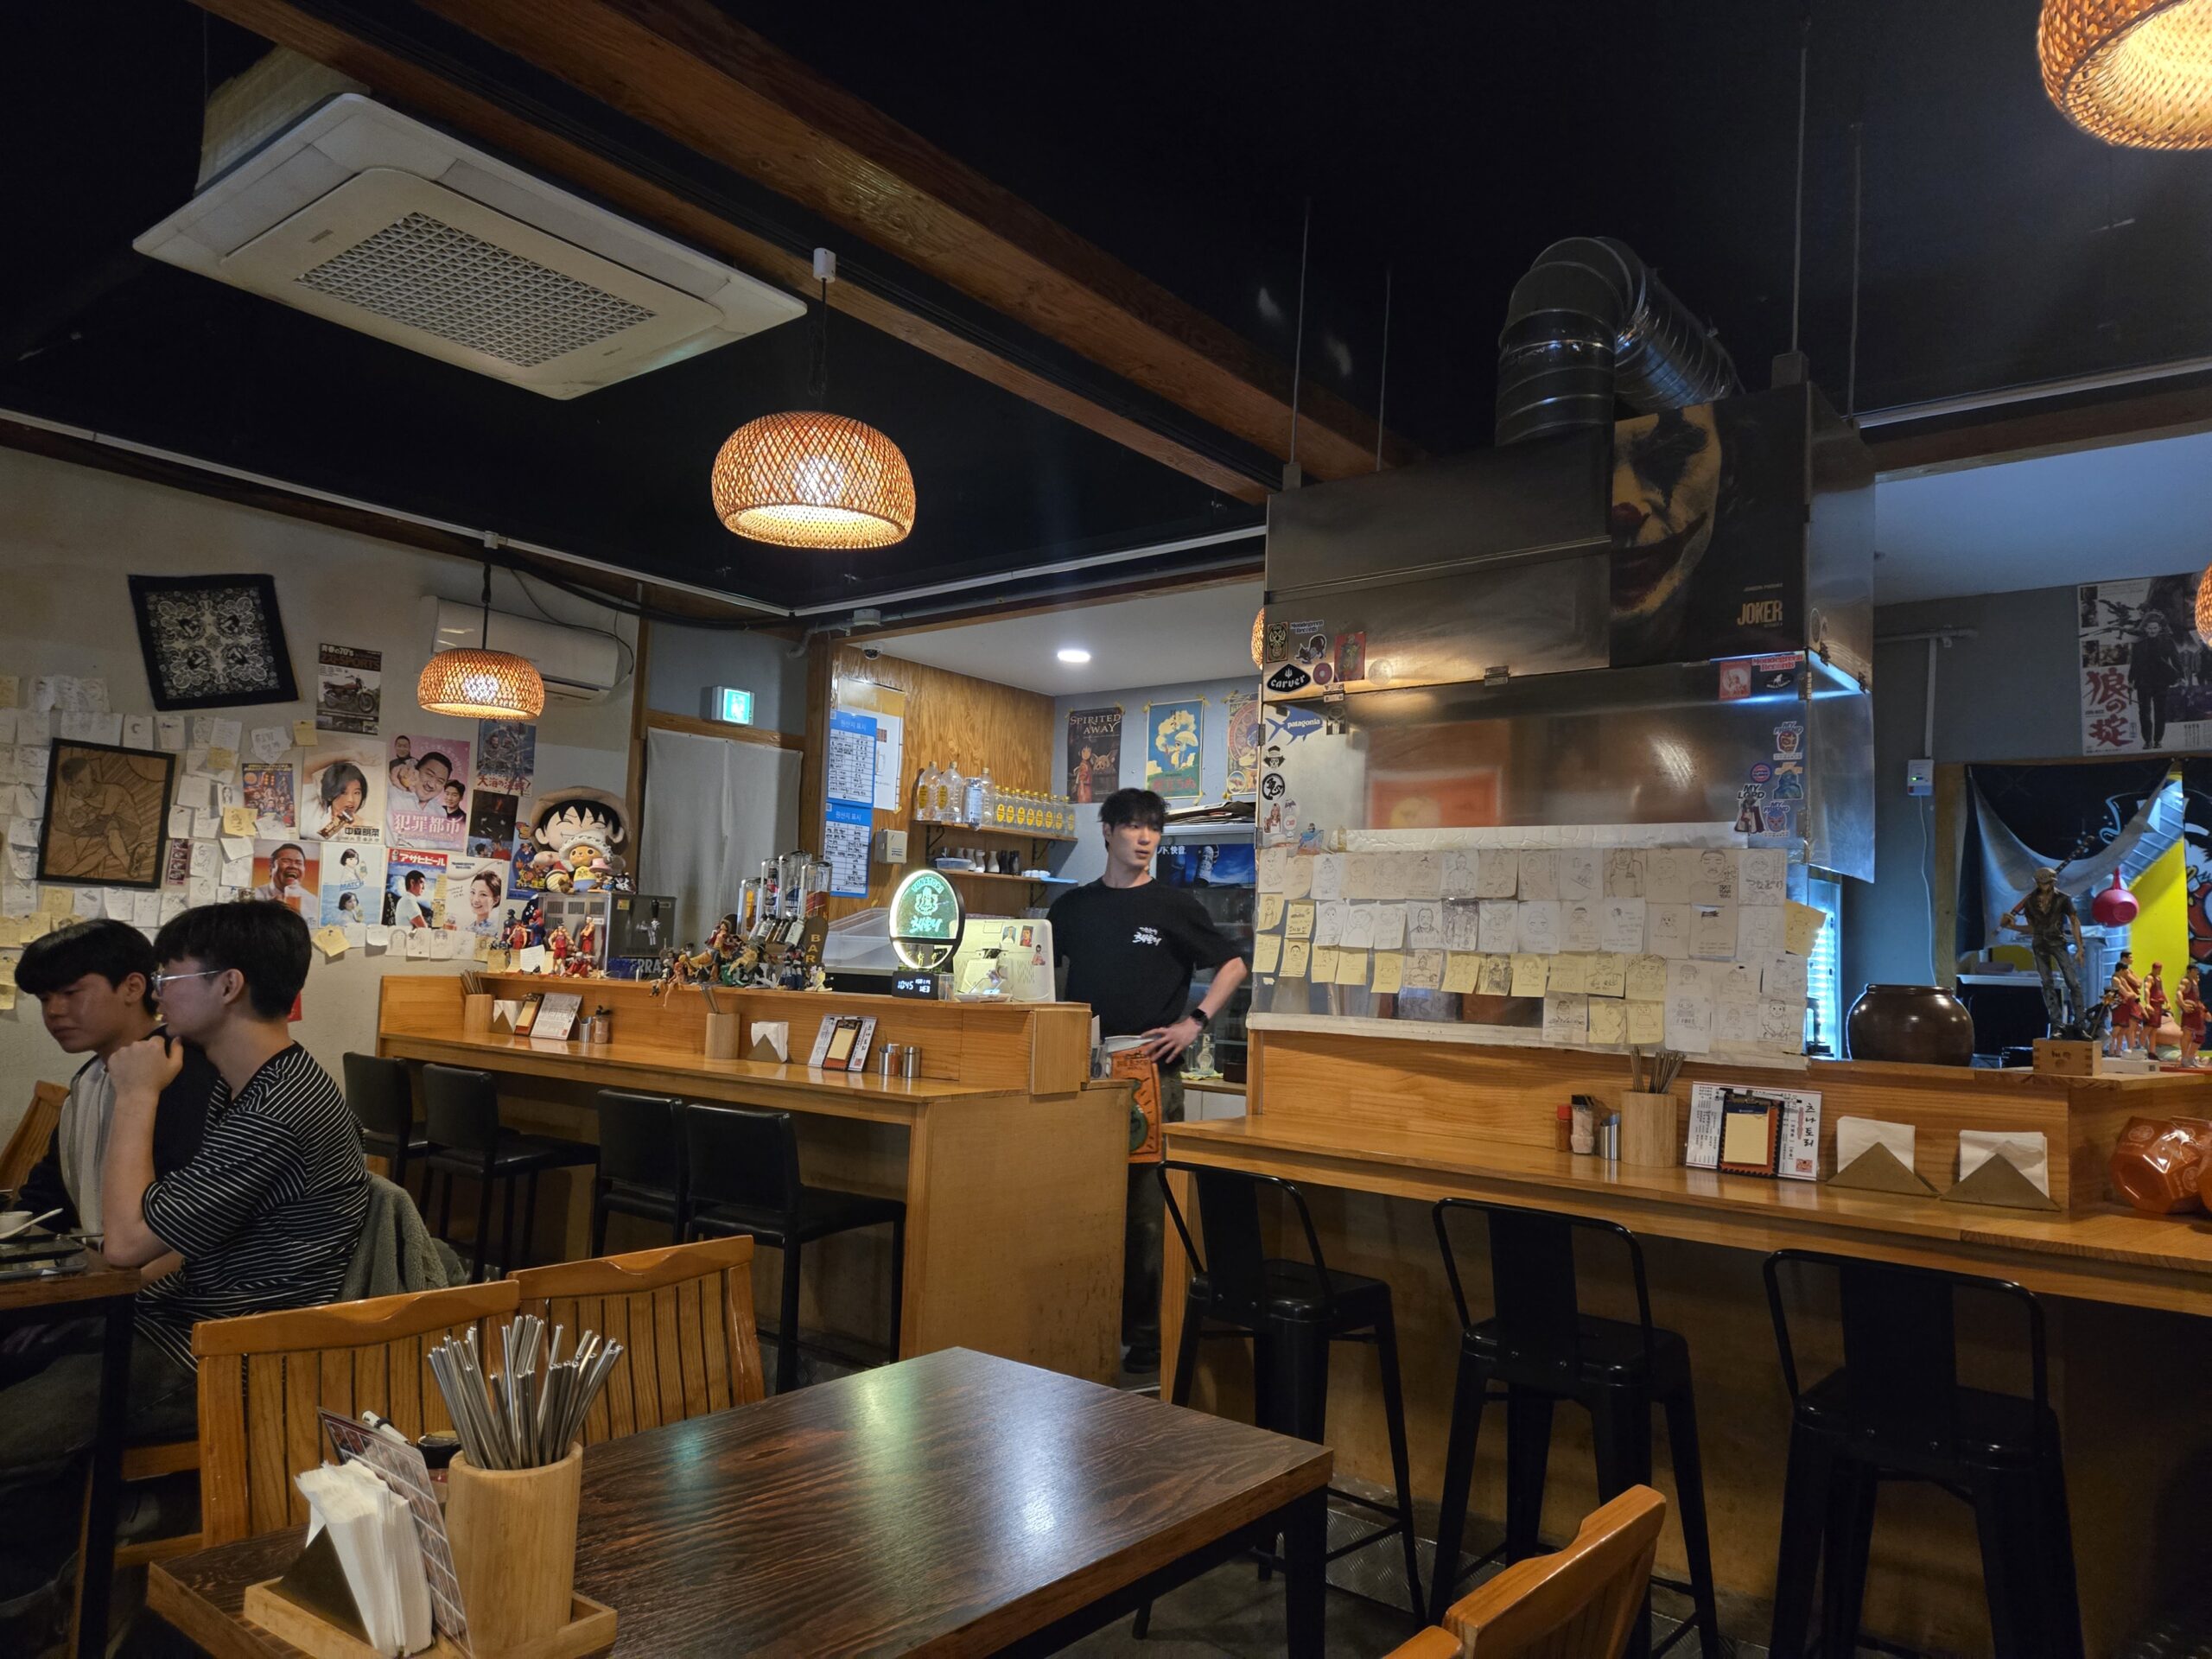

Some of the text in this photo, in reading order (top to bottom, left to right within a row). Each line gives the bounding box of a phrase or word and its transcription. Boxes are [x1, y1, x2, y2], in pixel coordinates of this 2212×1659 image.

[1737, 600, 1783, 626] JOKER
[1270, 675, 1306, 689] carver
[1070, 715, 1122, 726] SPIRITED
[1084, 721, 1121, 734] AWAY
[1287, 718, 1320, 728] patagonia
[394, 814, 461, 835] 犯罪都市
[399, 853, 446, 867] アサヒビール
[805, 933, 821, 963] BAR
[1803, 1103, 1817, 1147] 츠나토리
